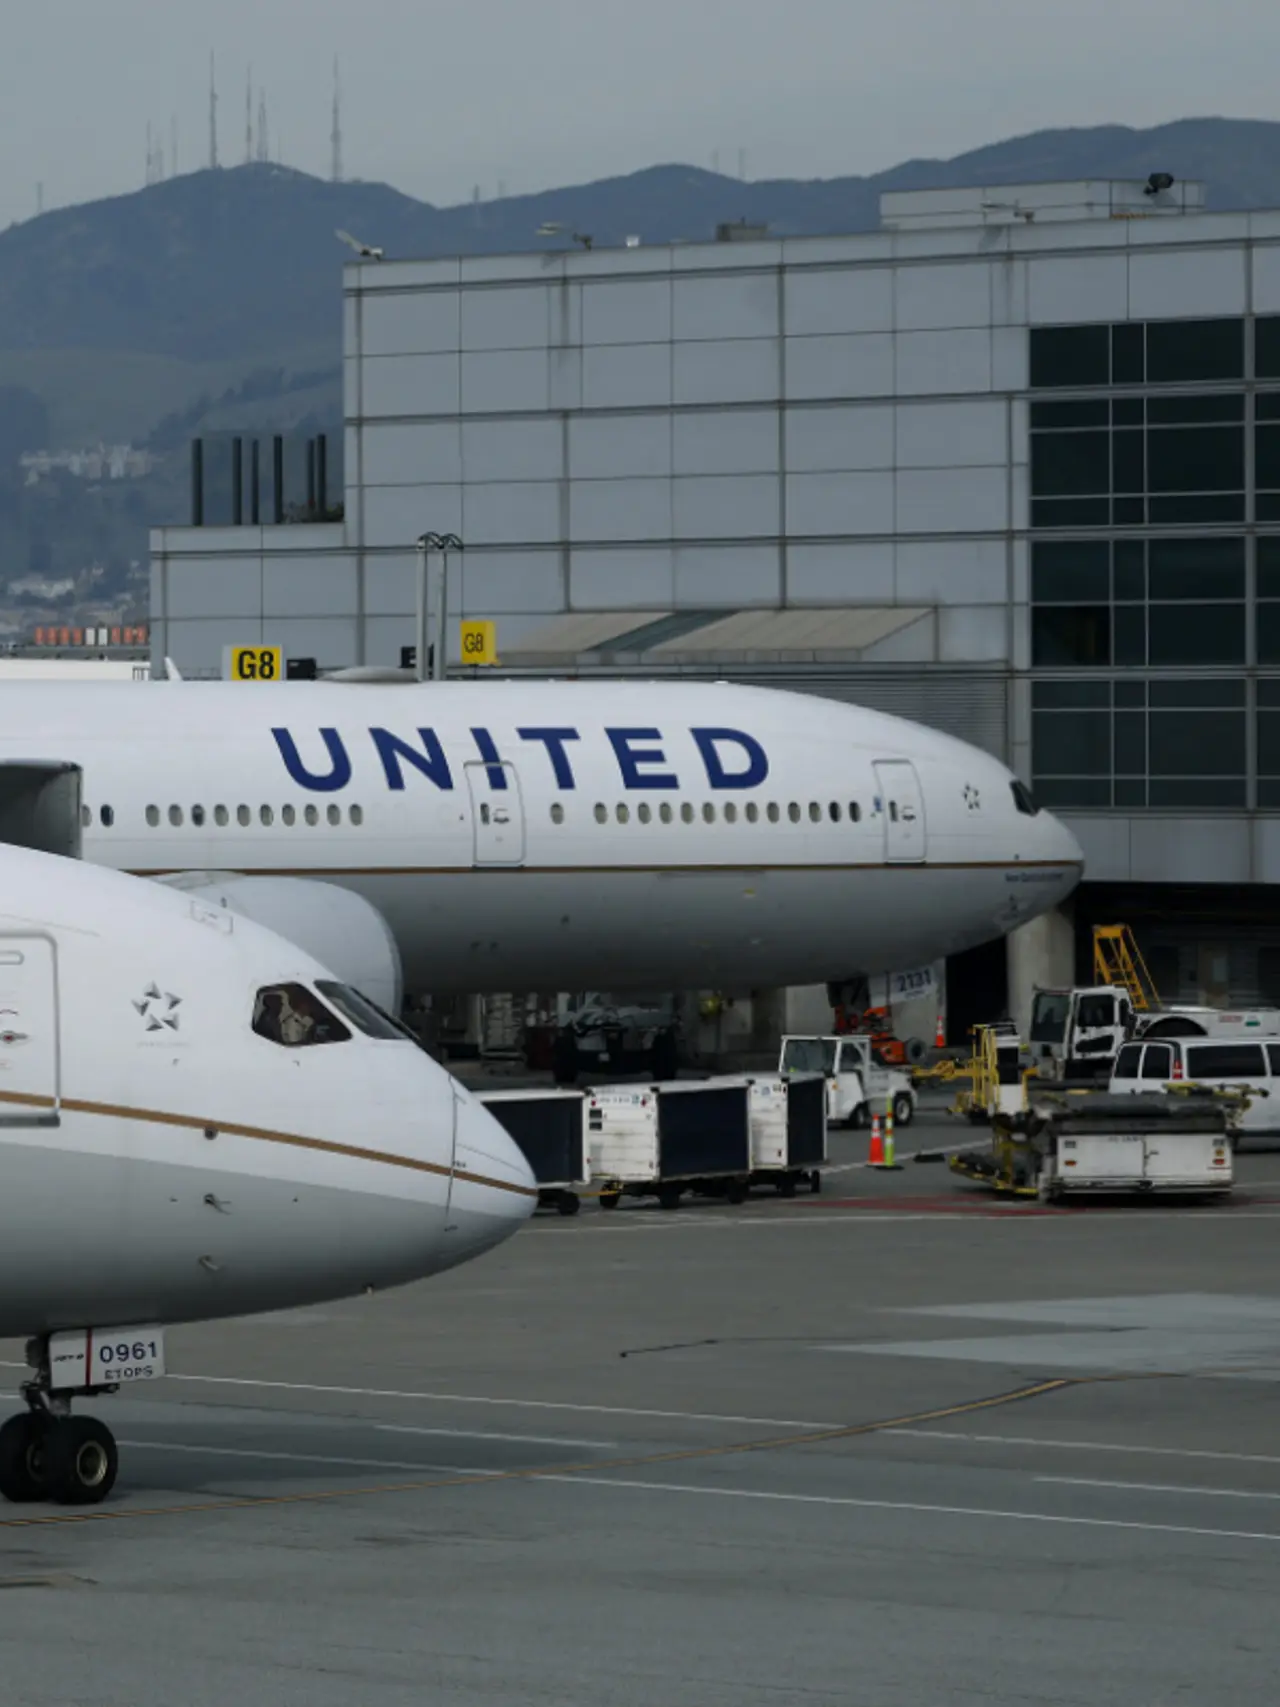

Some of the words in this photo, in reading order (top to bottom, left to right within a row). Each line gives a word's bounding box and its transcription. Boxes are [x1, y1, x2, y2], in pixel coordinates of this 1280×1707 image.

[463, 633, 484, 655] G8
[238, 650, 275, 680] G8
[271, 727, 768, 792] UNITED
[898, 968, 932, 993] 2131
[99, 1341, 157, 1364] 0961
[104, 1365, 153, 1381] ETOPS
